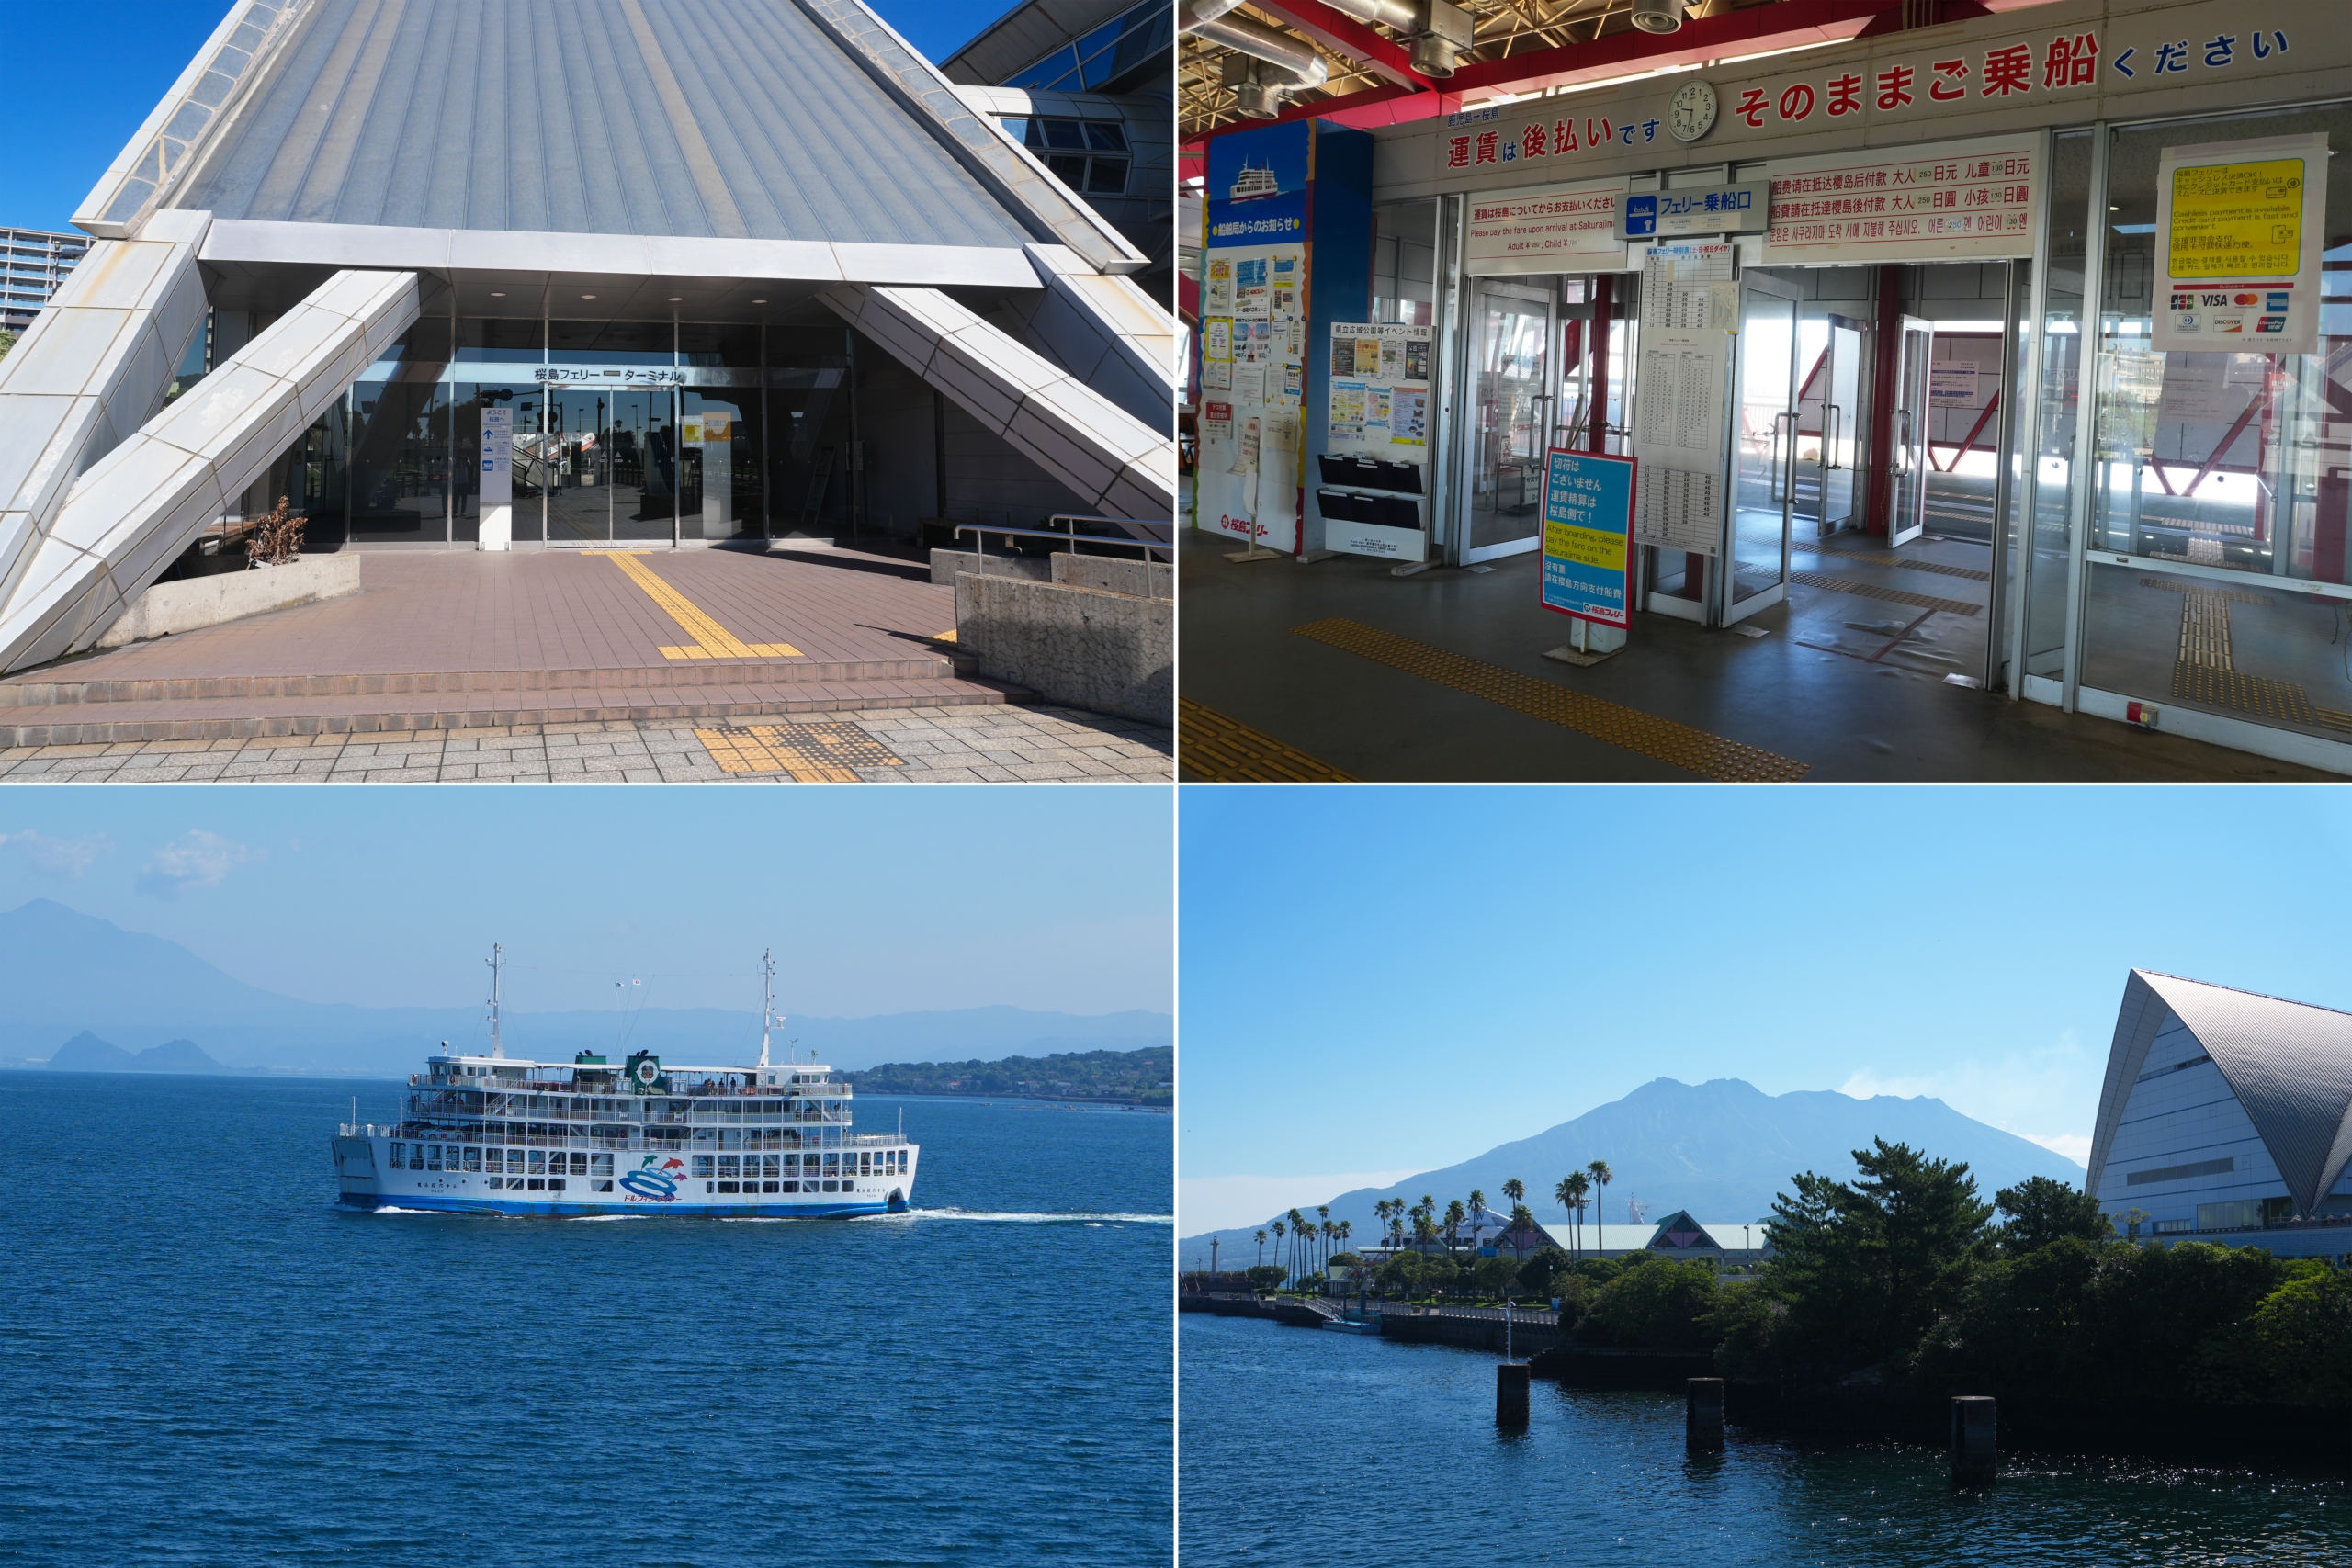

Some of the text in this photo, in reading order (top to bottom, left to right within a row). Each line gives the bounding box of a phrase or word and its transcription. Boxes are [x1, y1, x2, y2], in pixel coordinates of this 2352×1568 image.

[1689, 87, 1695, 96] 12
[1703, 94, 1708, 102] 2
[1447, 117, 1660, 169] 運賃は後払いです
[2177, 167, 2229, 177] 桜島フェリーは
[2176, 177, 2283, 190] 特にクレジットカード支払いは
[2176, 186, 2259, 197] スムーズに決済できます
[1660, 191, 1751, 215] フェリー乗船口
[2174, 209, 2208, 218] Cashless
[2210, 208, 2244, 217] payment
[2254, 205, 2291, 213] available.
[2218, 214, 2252, 223] payment
[1218, 217, 1293, 236] 船舶局からのお知らせ
[1470, 229, 1488, 238] Please
[1490, 229, 1501, 238] pay
[1502, 227, 1512, 235] the
[1514, 226, 1527, 234] fare
[1528, 224, 1544, 234] upon
[1545, 222, 1567, 233] arrival
[1569, 221, 1577, 231] at
[1770, 227, 1789, 242] 운임은
[1792, 225, 1825, 241] 사쿠라지마
[1828, 223, 1842, 239] 도착
[1846, 222, 1860, 238] 시에
[1863, 220, 1884, 237] 지불해
[1888, 220, 1920, 236] 주십시오.
[1508, 242, 1524, 250] Adult
[1544, 240, 1562, 249] Child
[2200, 294, 2228, 307] VISA
[535, 368, 681, 382] 桜島フェリー ターミナル
[1555, 457, 1579, 472] 切符は
[1552, 474, 1602, 491] ございません
[1551, 490, 1596, 508] 運賃精算は
[1546, 525, 1624, 547] After boarding, please
[1545, 545, 1581, 560] Sakurajima
[1546, 536, 1557, 545] pay
[1558, 536, 1570, 547] the
[1572, 540, 1586, 550] fare
[1599, 546, 1612, 556] the
[1591, 605, 1624, 618] 桜島フェリー
